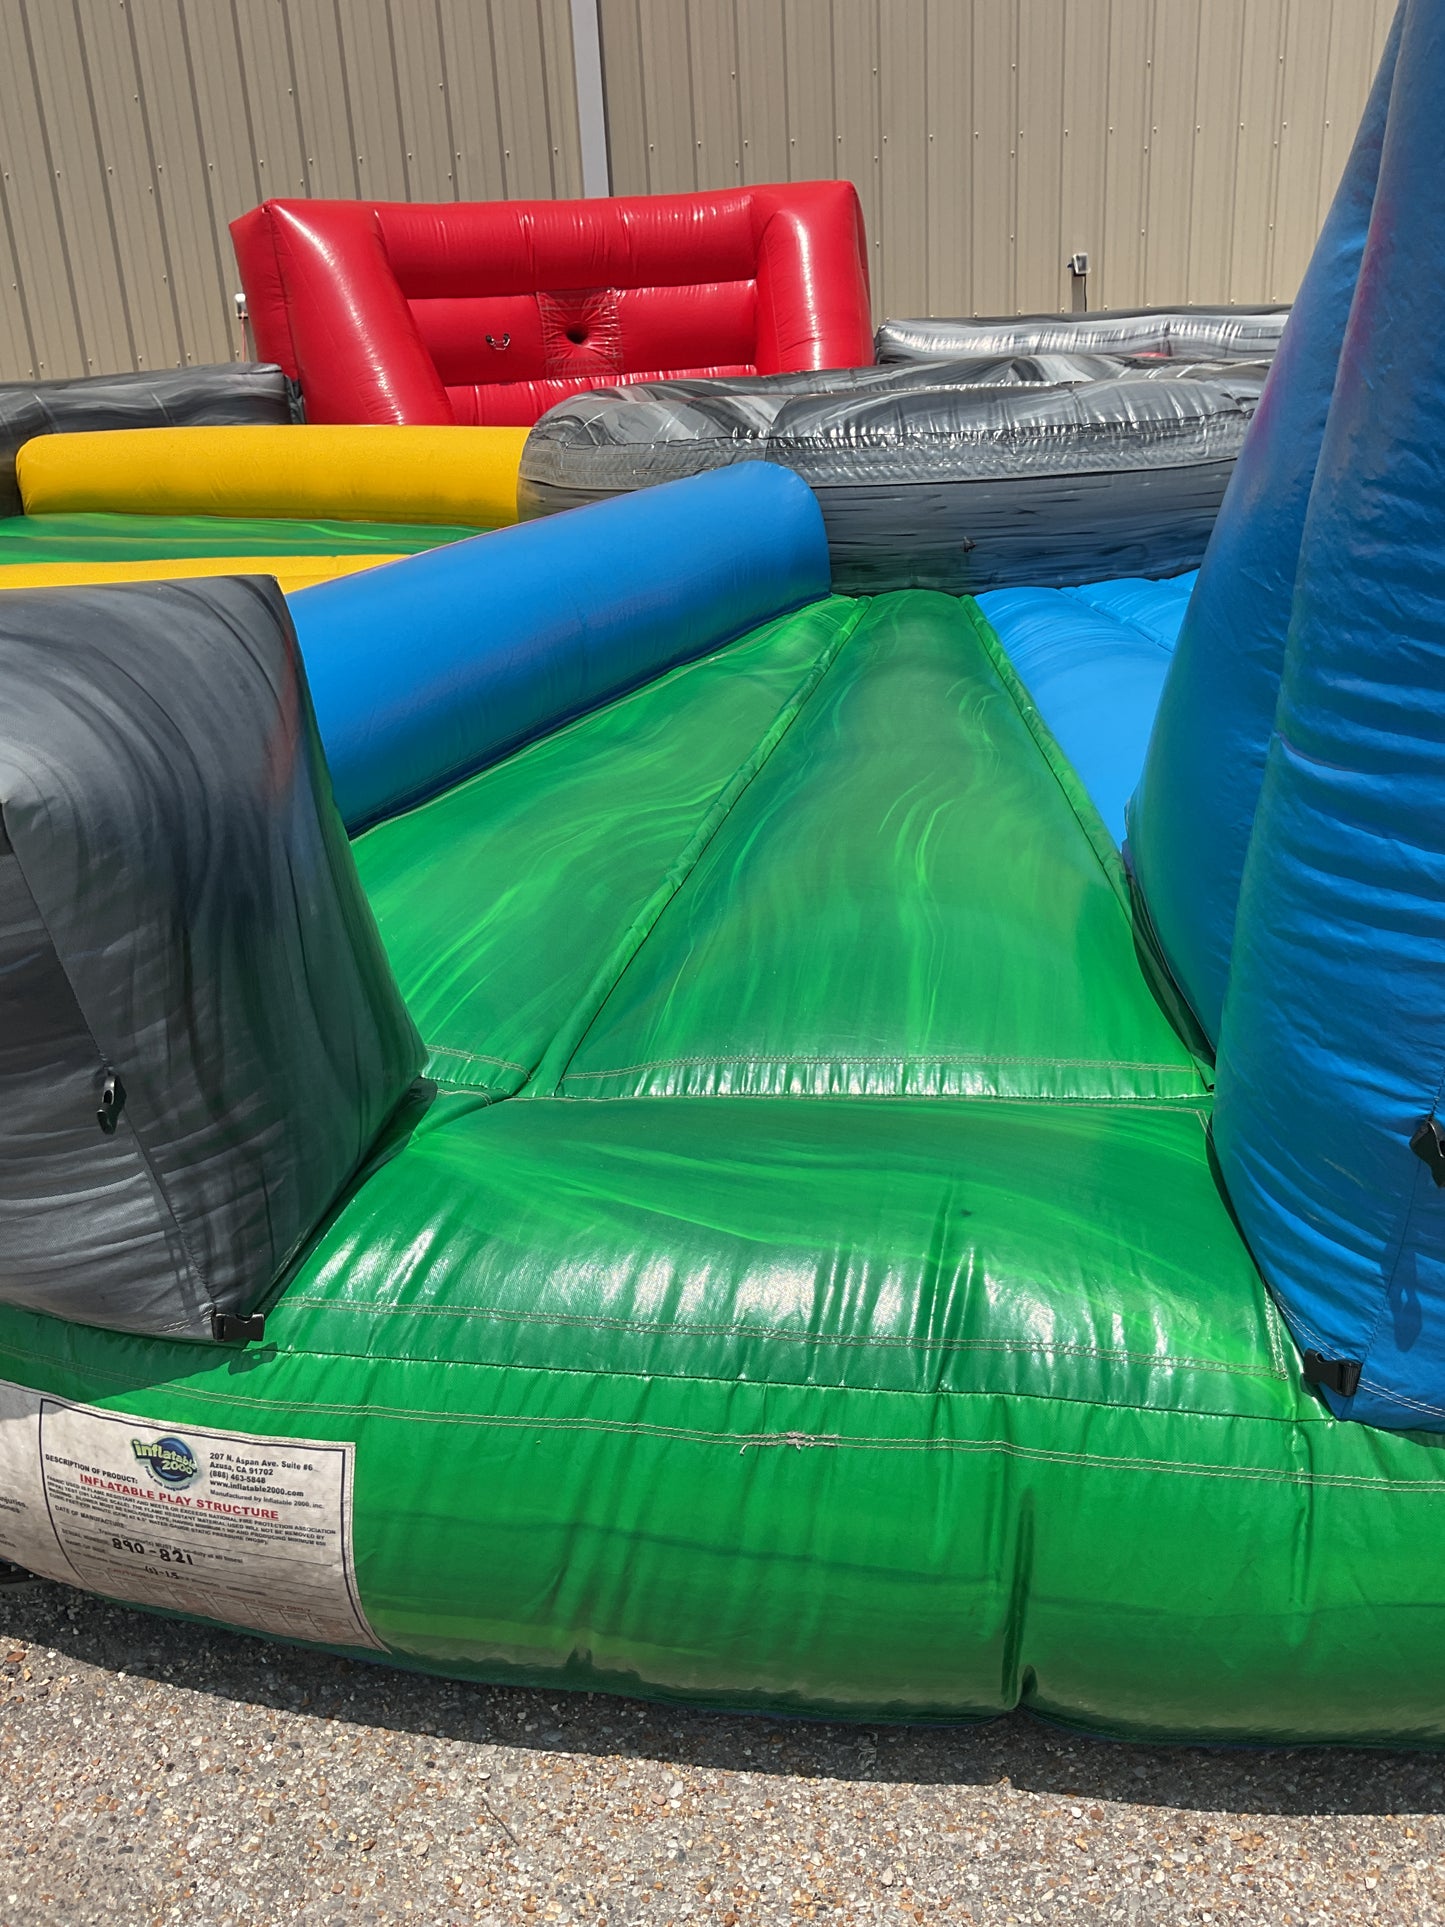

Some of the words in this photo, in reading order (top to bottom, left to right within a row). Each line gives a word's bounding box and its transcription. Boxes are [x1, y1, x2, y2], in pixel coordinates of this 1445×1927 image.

[45, 1453, 90, 1472] DESCRIPTION
[91, 1467, 101, 1475] OF
[102, 1470, 138, 1484] PRODUCT:
[161, 1459, 193, 1475] 2000
[209, 1452, 225, 1460] 207
[226, 1454, 235, 1462] N.
[236, 1456, 259, 1467] Aspan
[261, 1459, 279, 1467] Ave.
[281, 1460, 301, 1470] Suite
[303, 1463, 314, 1471] #6
[209, 1461, 234, 1473] Azusa,
[236, 1465, 247, 1473] CA
[249, 1467, 274, 1476] 91702
[209, 1469, 229, 1480] (888)
[230, 1473, 266, 1484] 463-5848
[80, 1474, 155, 1499] INFLATABLE
[159, 1492, 191, 1506] PLAY
[196, 1499, 279, 1519] STRUCTURE
[209, 1480, 305, 1497] www.inflatable2000.com
[209, 1489, 252, 1501] Manufactured
[144, 1507, 163, 1515] FLAME
[164, 1511, 196, 1522] RESISTANT
[196, 1517, 226, 1527] MATERIAL
[227, 1522, 244, 1530] USED
[284, 1530, 315, 1540] REMOVED
[149, 1502, 169, 1510] MEETS
[179, 1508, 207, 1517] EXCEEDS
[208, 1513, 238, 1522] NATIONAL
[254, 1519, 294, 1530] PROTECTION
[294, 1525, 336, 1535] ASSOCIATION
